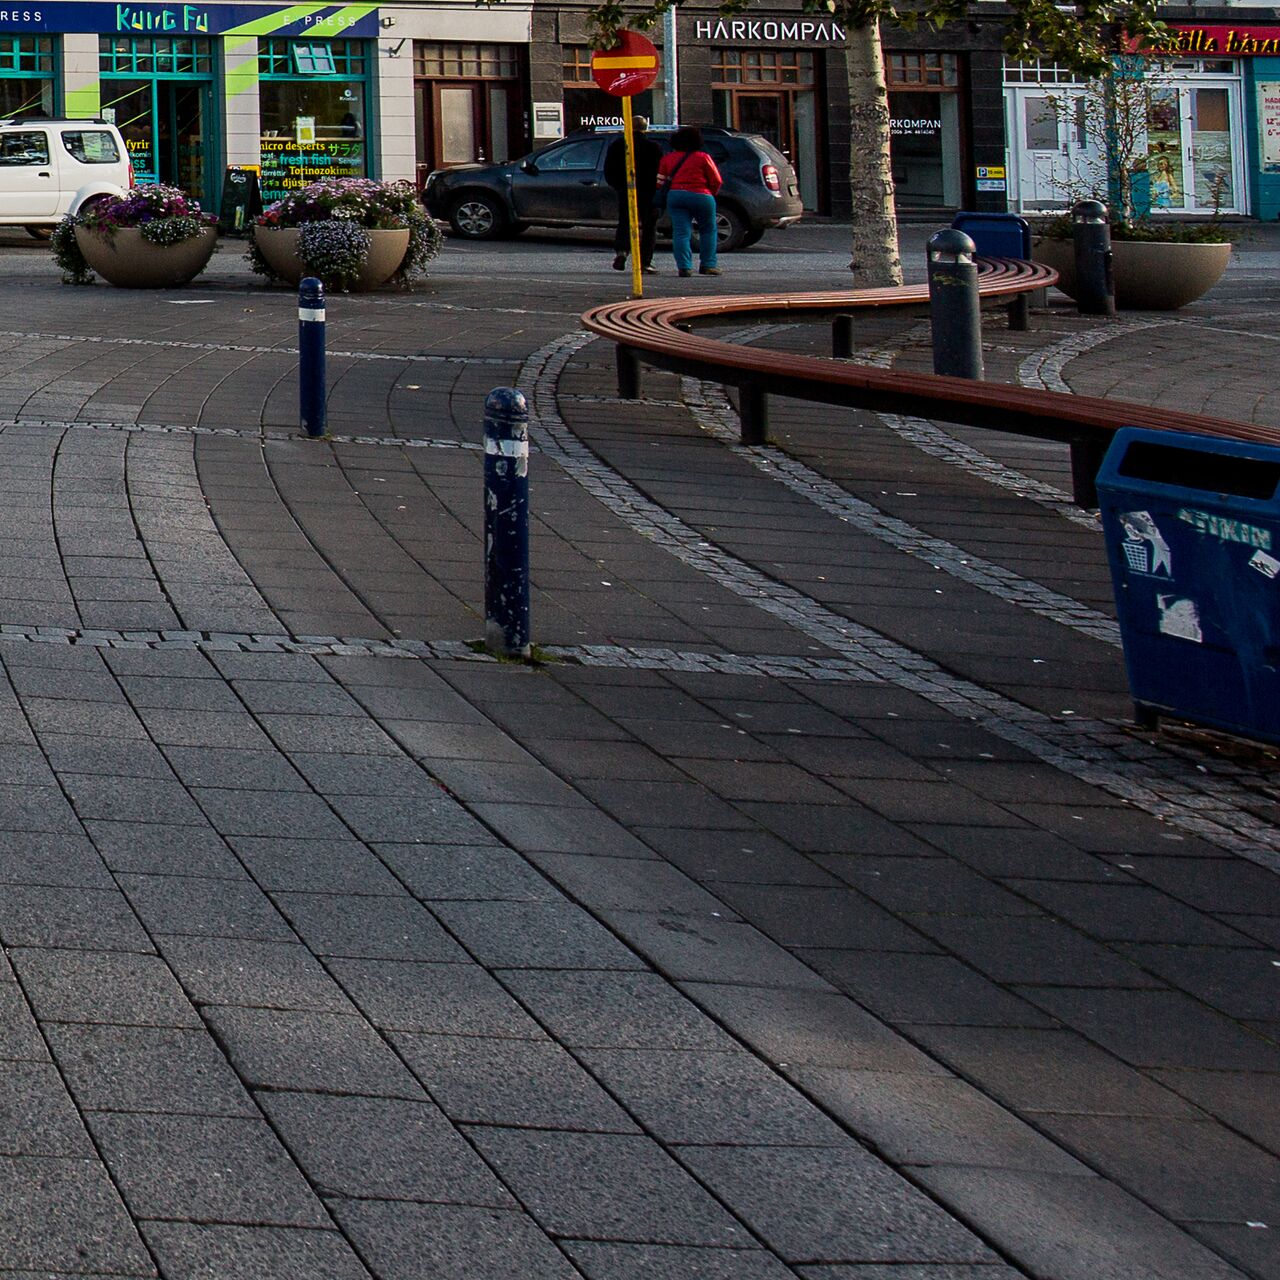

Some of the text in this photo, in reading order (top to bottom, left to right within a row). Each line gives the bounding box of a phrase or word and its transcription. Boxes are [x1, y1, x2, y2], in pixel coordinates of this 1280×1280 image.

[283, 15, 357, 28] EXPRESS
[696, 17, 846, 41] HÁRKOMPAN
[889, 119, 941, 129] RKOMPAN
[285, 141, 325, 151] desserts
[279, 153, 309, 165] fresh
[311, 153, 332, 165] fish
